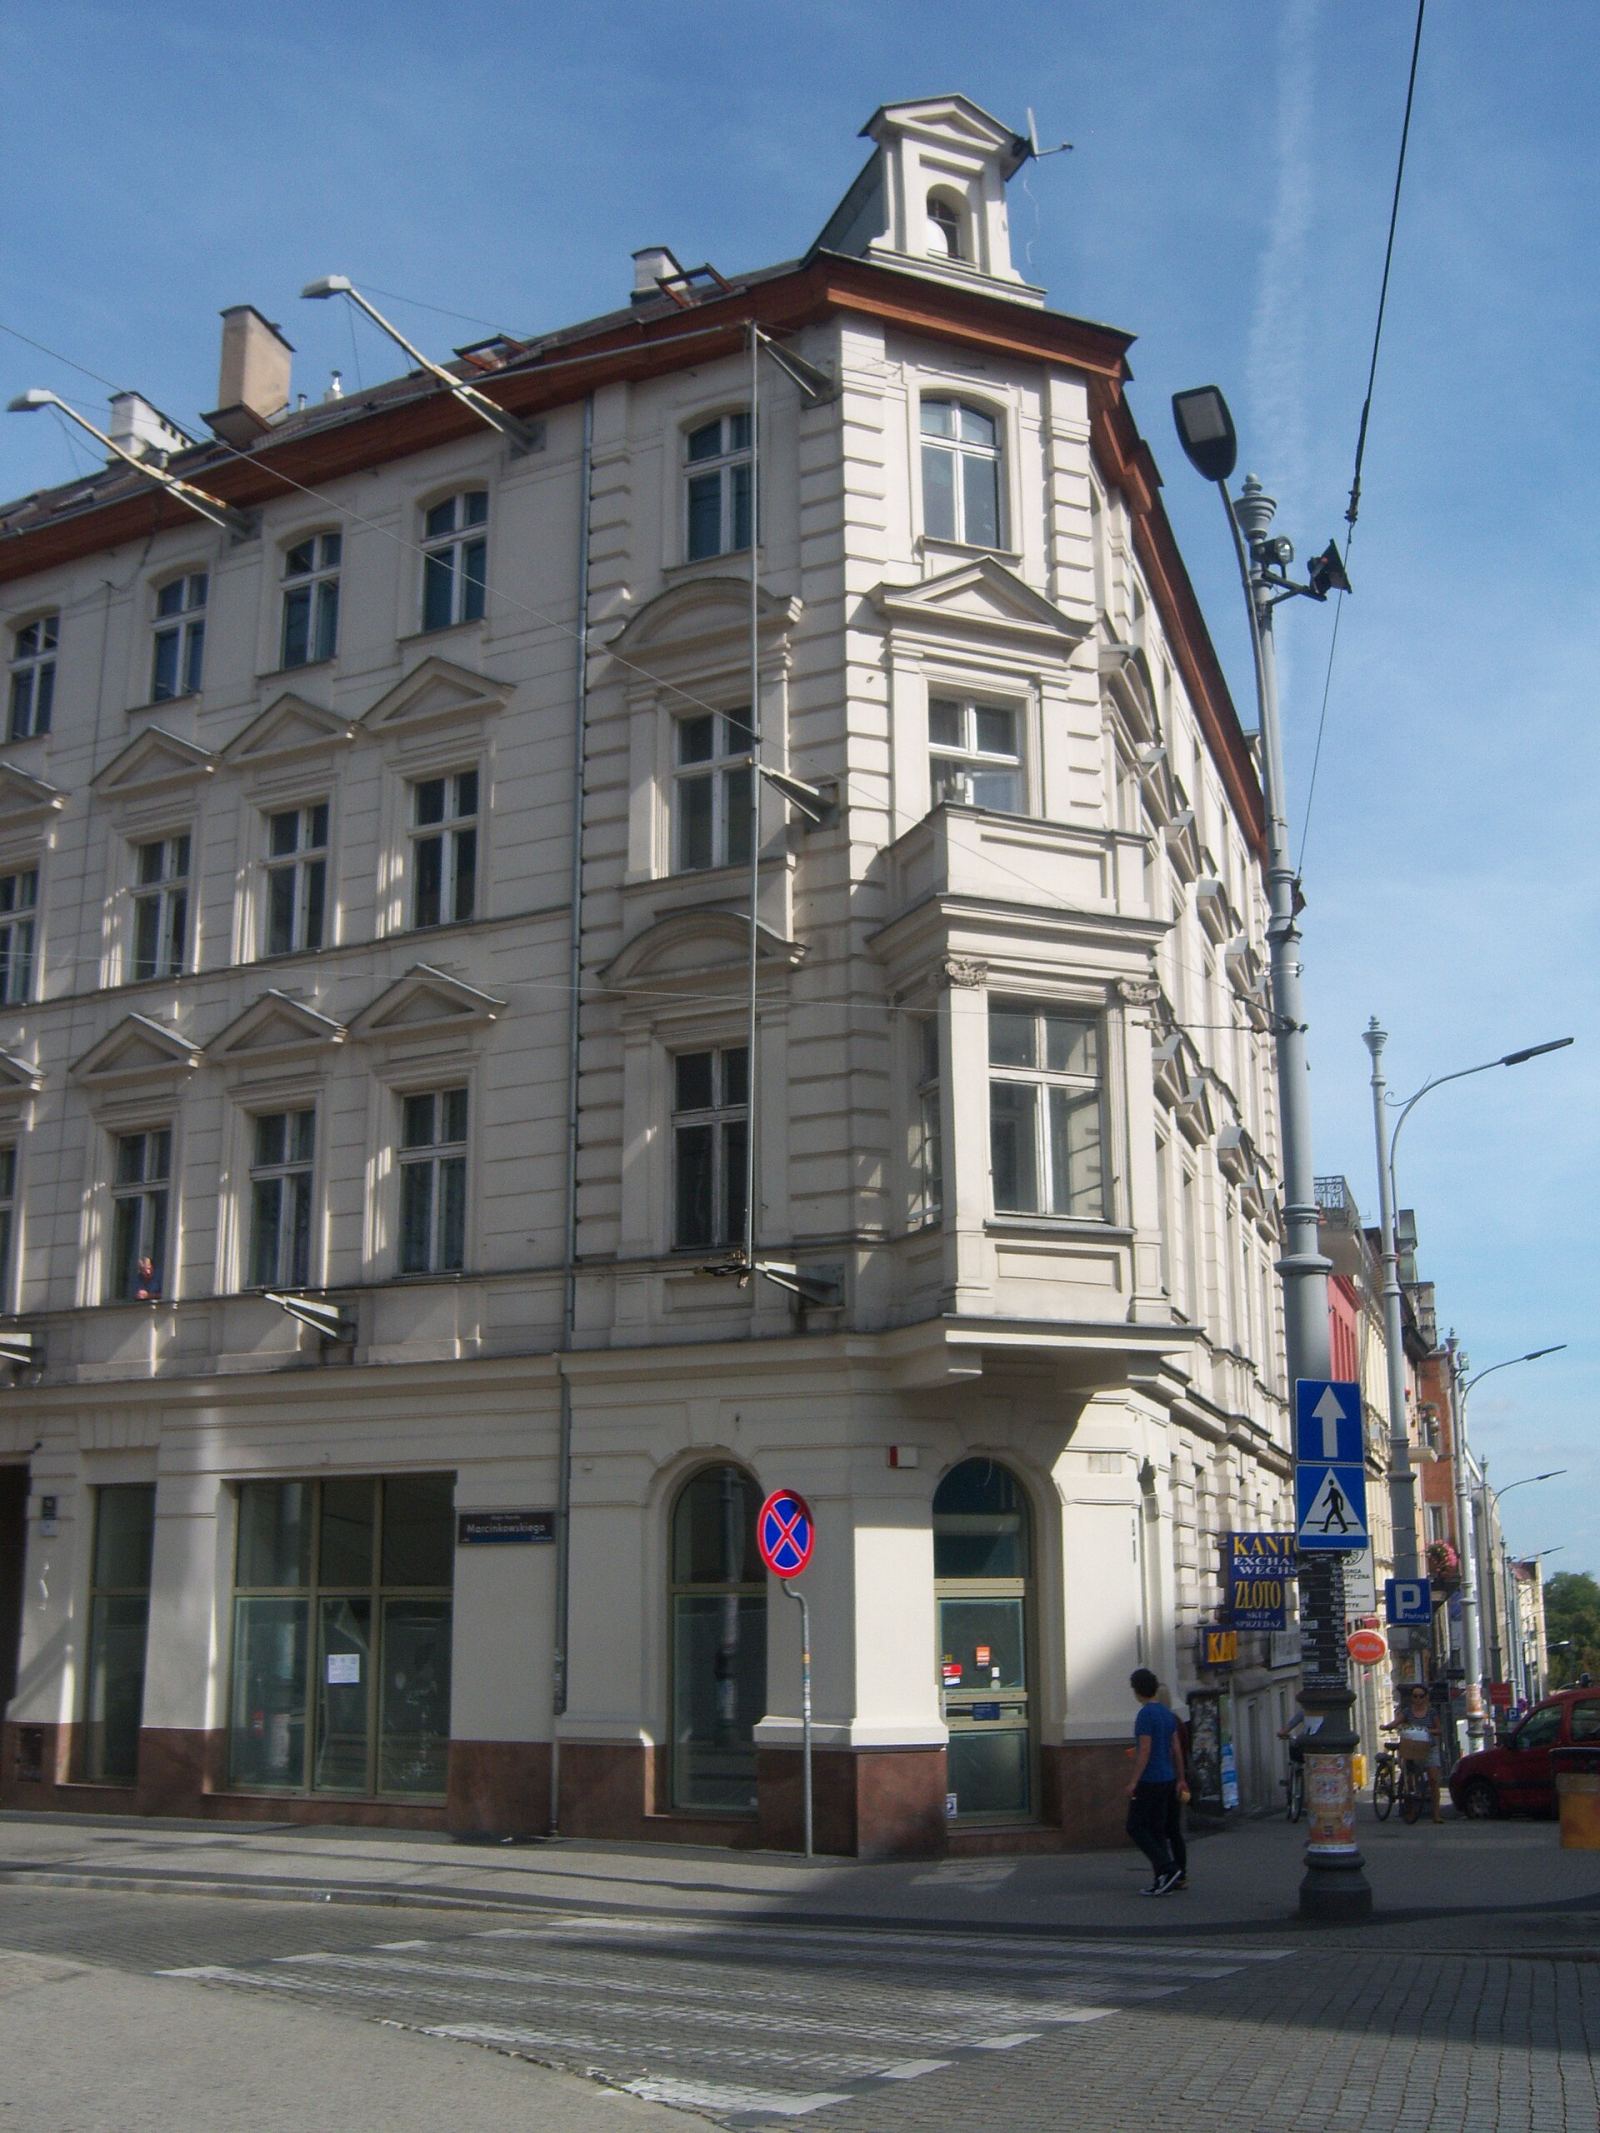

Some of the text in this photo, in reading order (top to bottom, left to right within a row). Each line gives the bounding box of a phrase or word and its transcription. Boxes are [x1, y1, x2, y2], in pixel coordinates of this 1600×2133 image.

[466, 1523, 546, 1535] Marcinkowskiego
[1233, 1535, 1298, 1556] KANT
[1234, 1580, 1281, 1609] ZŁOTO
